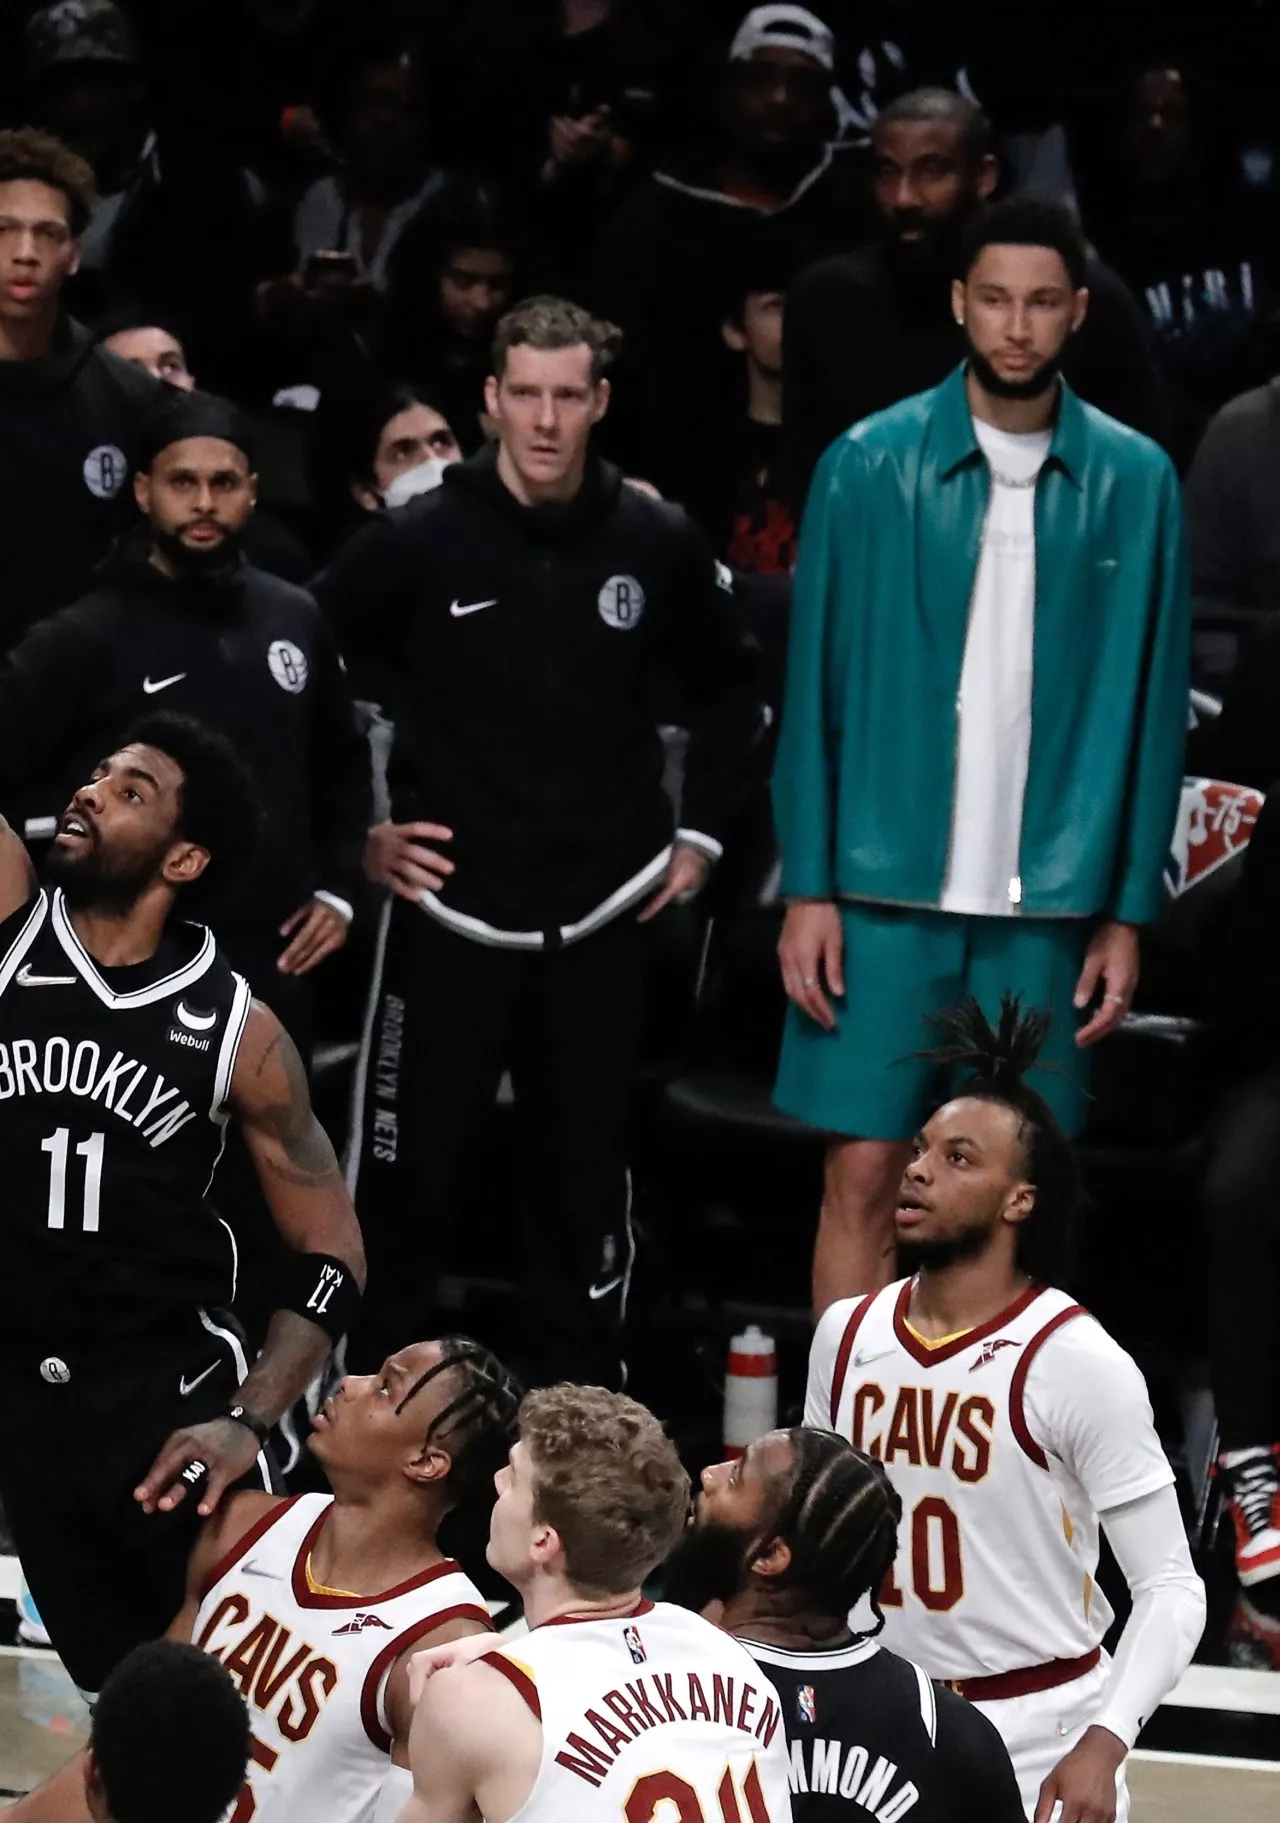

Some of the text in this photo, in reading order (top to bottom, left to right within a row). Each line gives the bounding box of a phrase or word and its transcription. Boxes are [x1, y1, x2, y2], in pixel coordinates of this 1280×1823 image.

[169, 1029, 210, 1052] Webull
[373, 994, 405, 1163] BROOKLYN NETS
[40, 1127, 106, 1232] 11
[306, 1278, 335, 1314] 11
[320, 1264, 344, 1288] KAI
[851, 1381, 996, 1486] CAVS
[194, 1592, 338, 1743] CAVS
[554, 1672, 781, 1789] MARKKANEN
